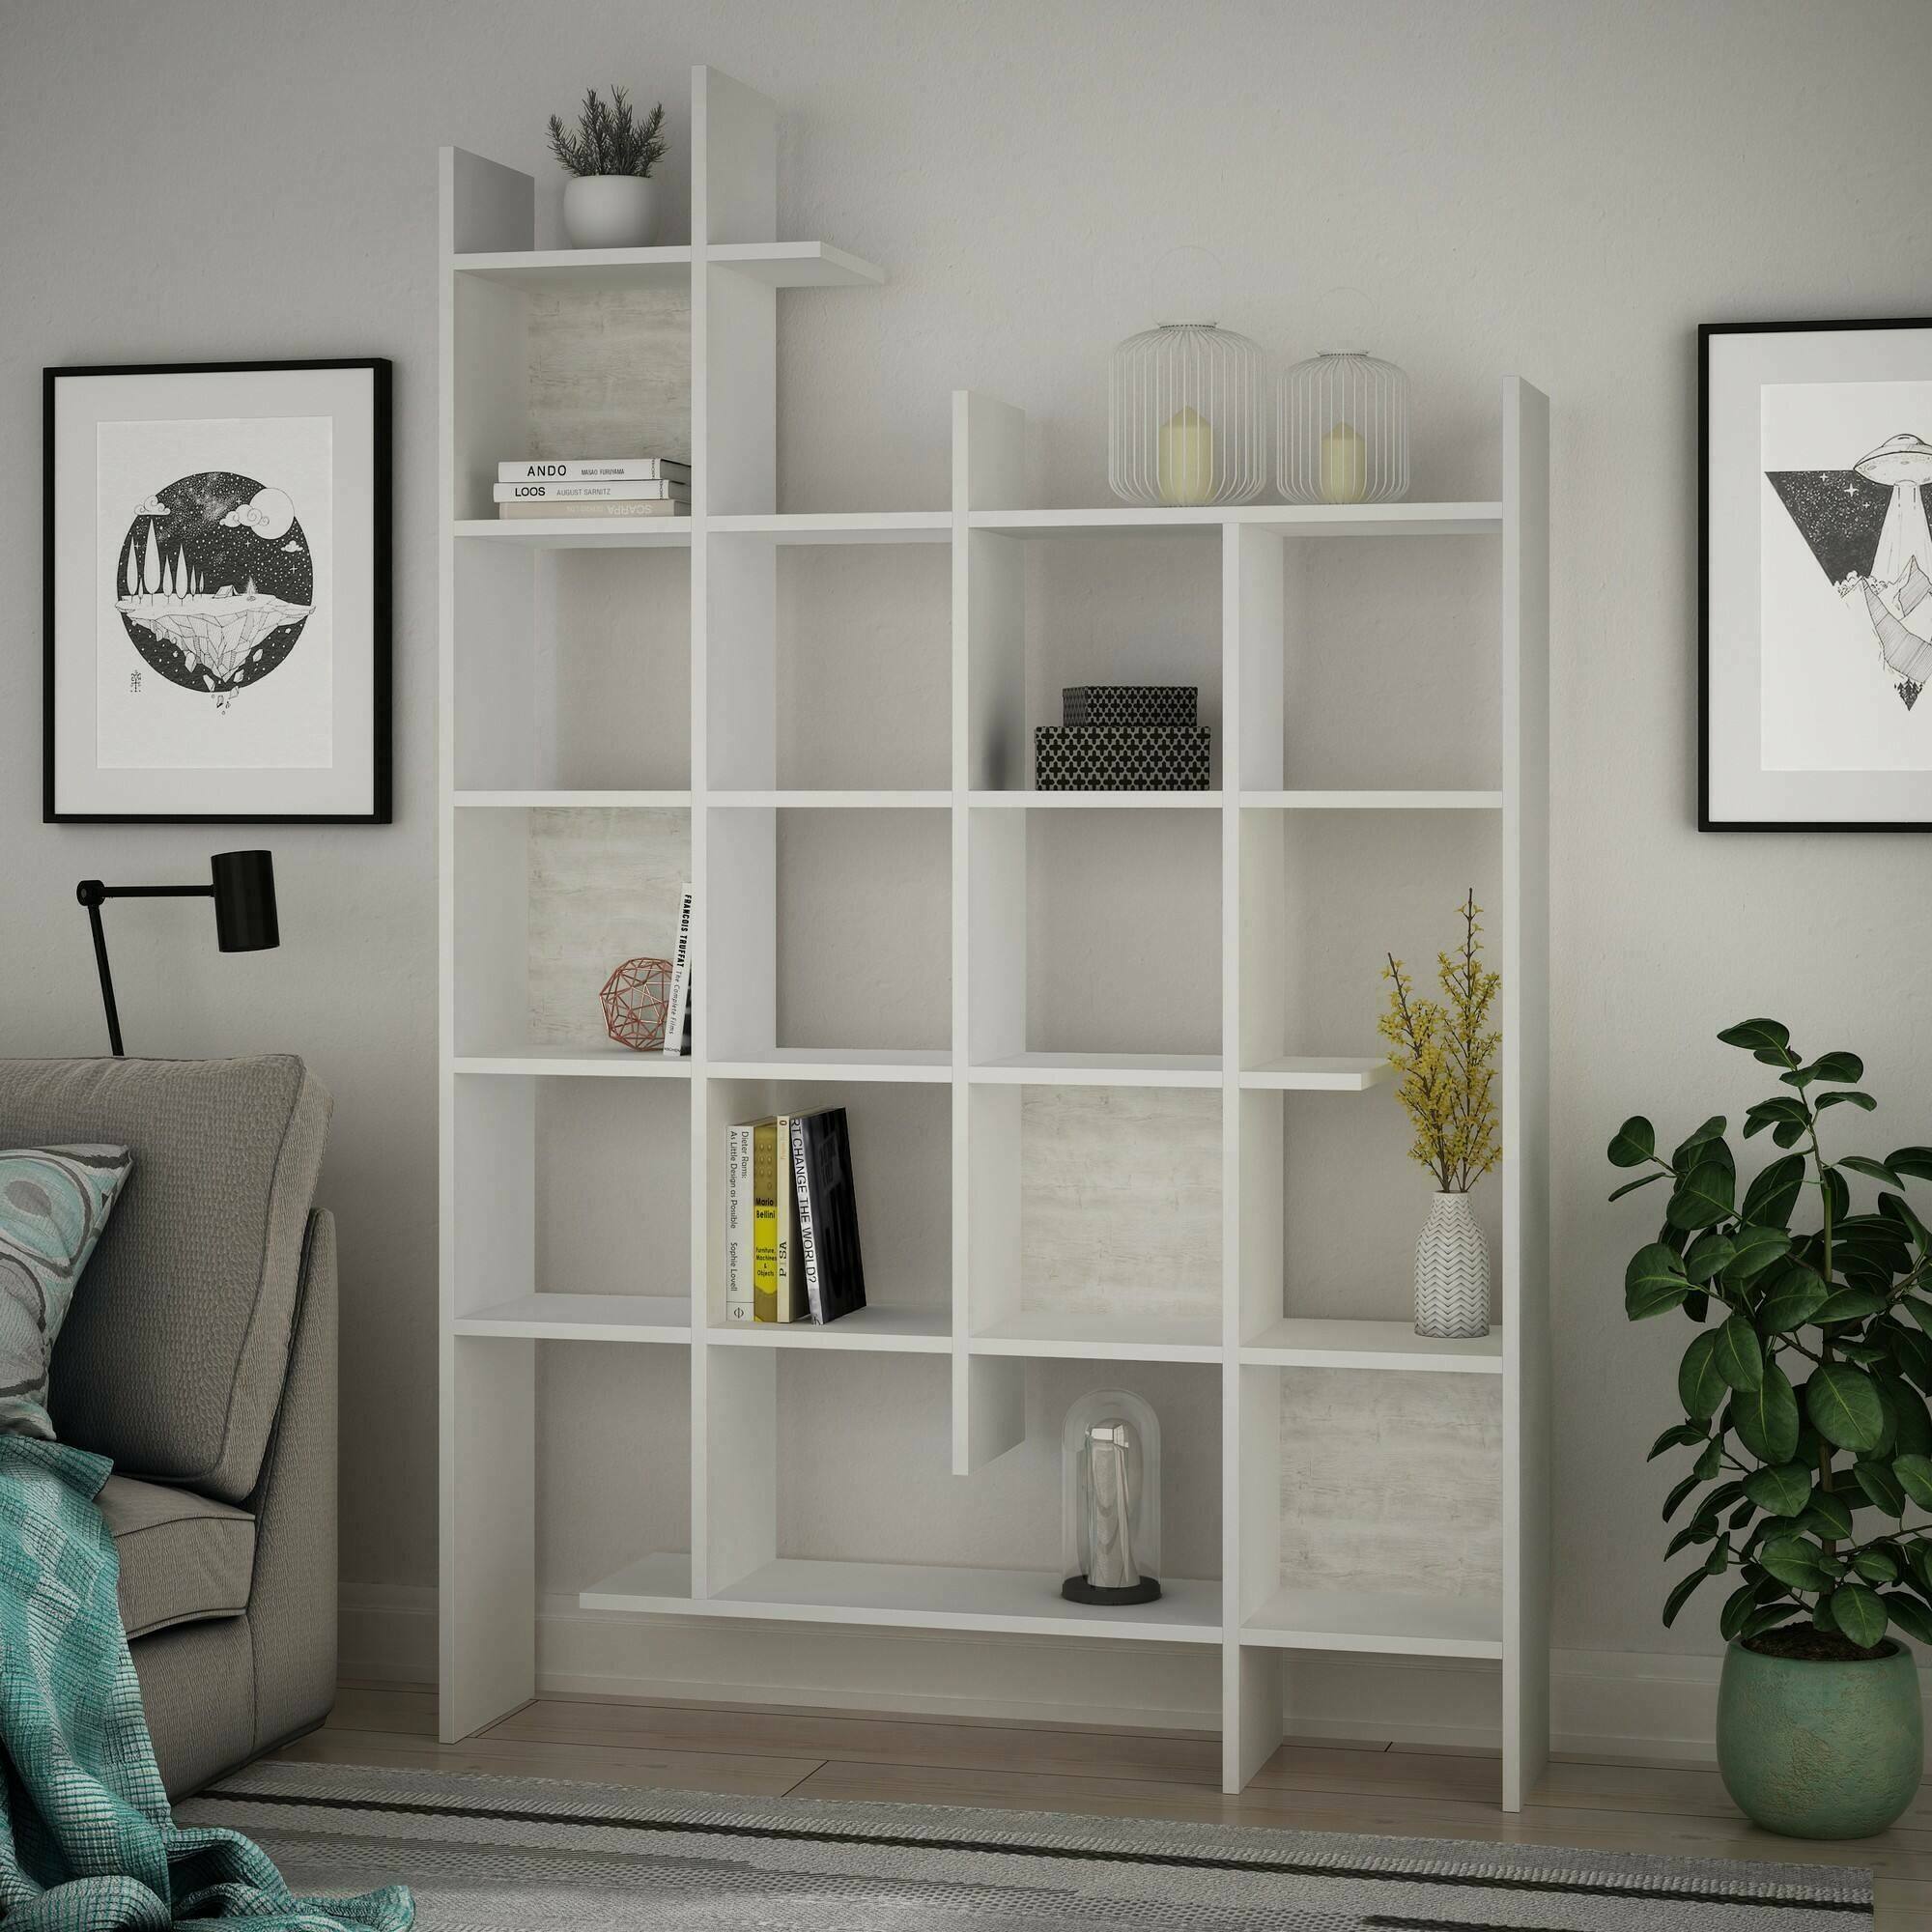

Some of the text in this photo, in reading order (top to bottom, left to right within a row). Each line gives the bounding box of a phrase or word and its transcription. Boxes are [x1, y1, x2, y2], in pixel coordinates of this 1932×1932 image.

[526, 465, 567, 477] ANDO
[515, 486, 546, 497] LOOS
[607, 503, 653, 516] SCARPA
[681, 894, 693, 933] FRANCOIS
[676, 935, 688, 968] TRUFFAT
[670, 984, 680, 1015] Complete
[668, 1017, 677, 1035] Films
[730, 1130, 738, 1140] As
[729, 1163, 738, 1190] Design
[792, 1138, 808, 1193] CHANGE
[755, 1198, 774, 1207] Mario
[756, 1209, 776, 1219] Bellini
[799, 1198, 811, 1223] THE
[729, 1242, 738, 1266] Sophie
[802, 1227, 817, 1283] WORLD?
